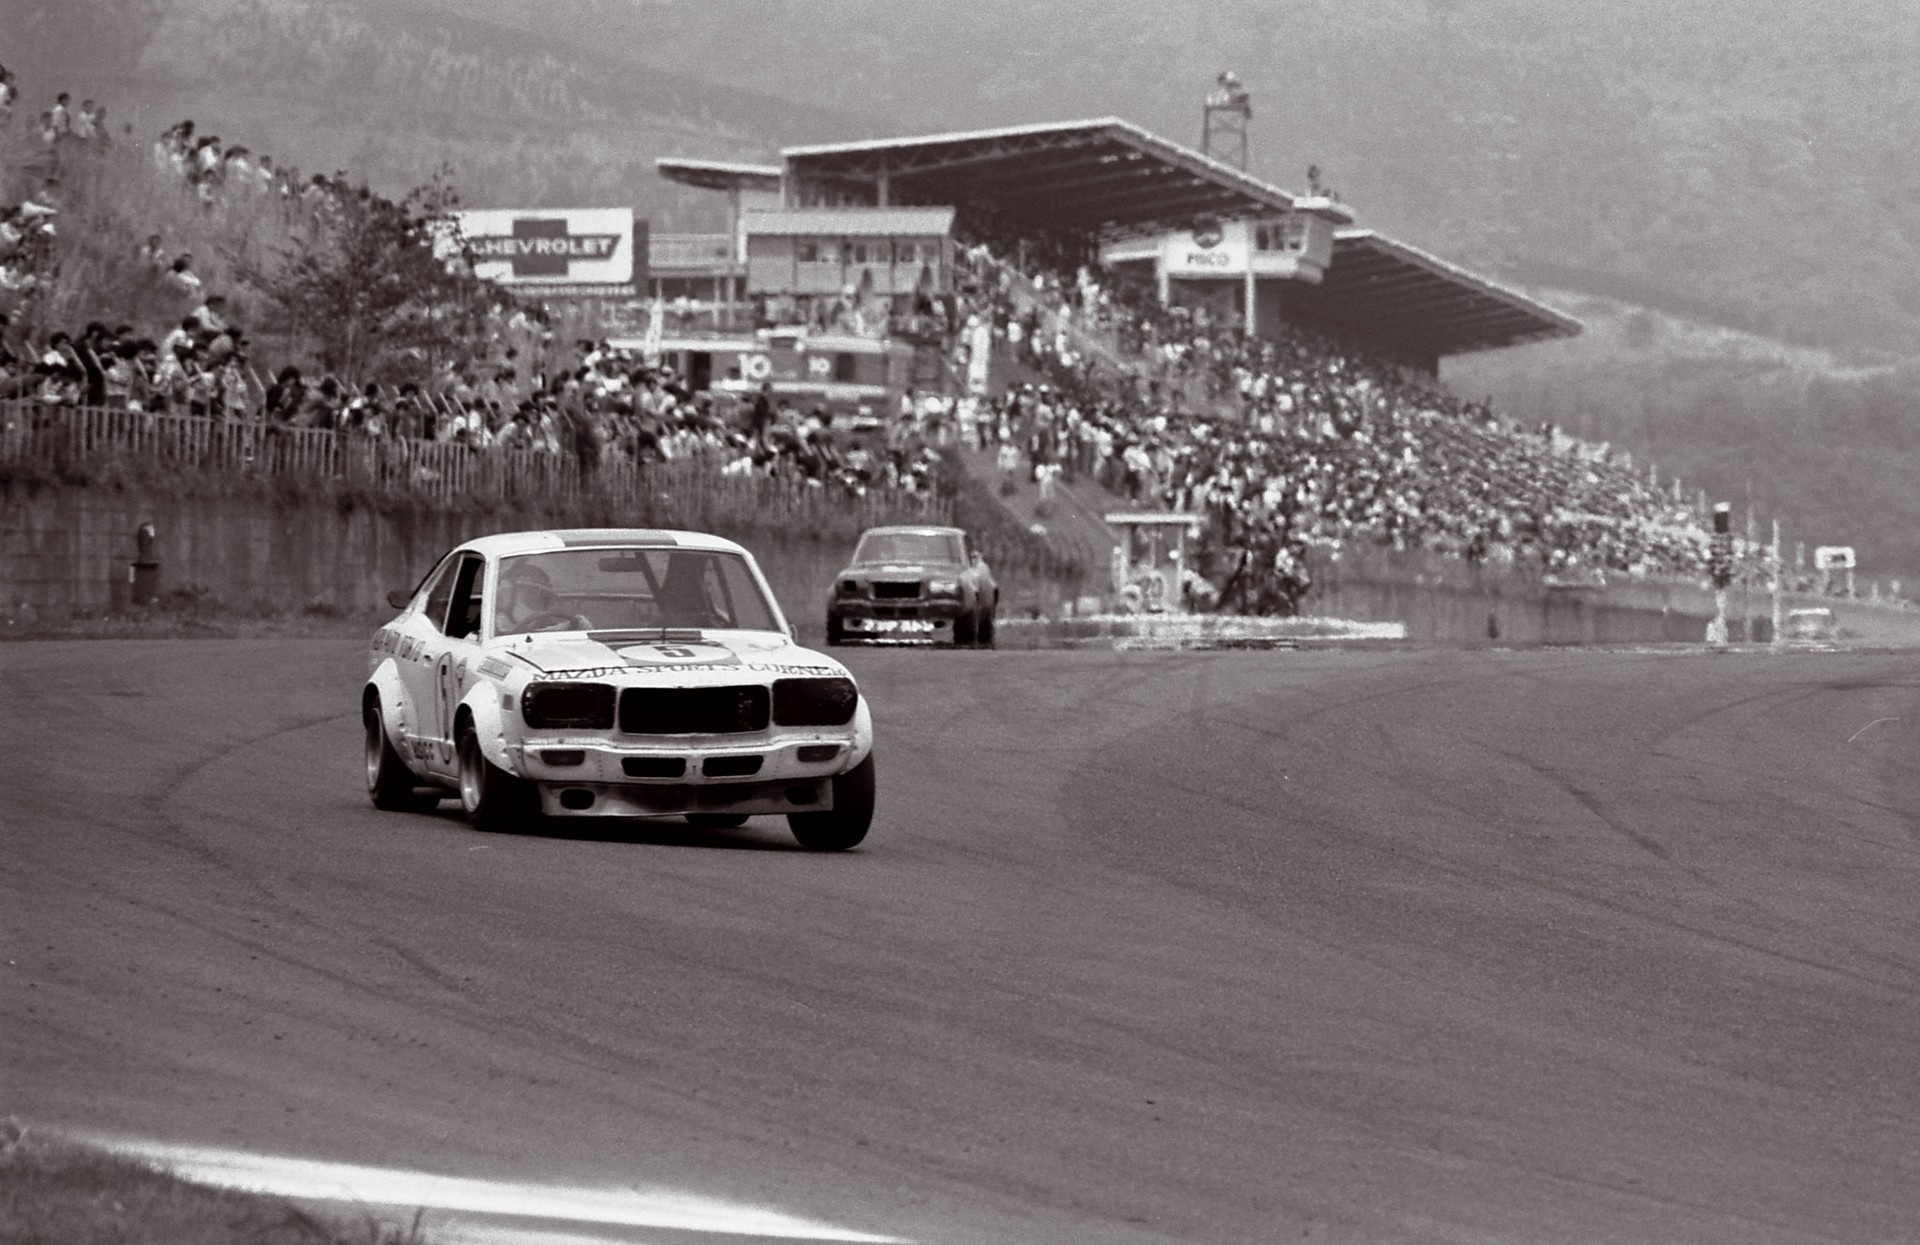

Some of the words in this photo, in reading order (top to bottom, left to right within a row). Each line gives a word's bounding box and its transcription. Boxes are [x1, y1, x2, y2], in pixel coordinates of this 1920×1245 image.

[468, 237, 613, 254] CHEVROLET
[737, 353, 771, 379] 10
[653, 646, 696, 657] 5
[532, 667, 628, 681] MAZDA
[637, 664, 740, 673] SPORTS
[748, 662, 847, 676] CORNER
